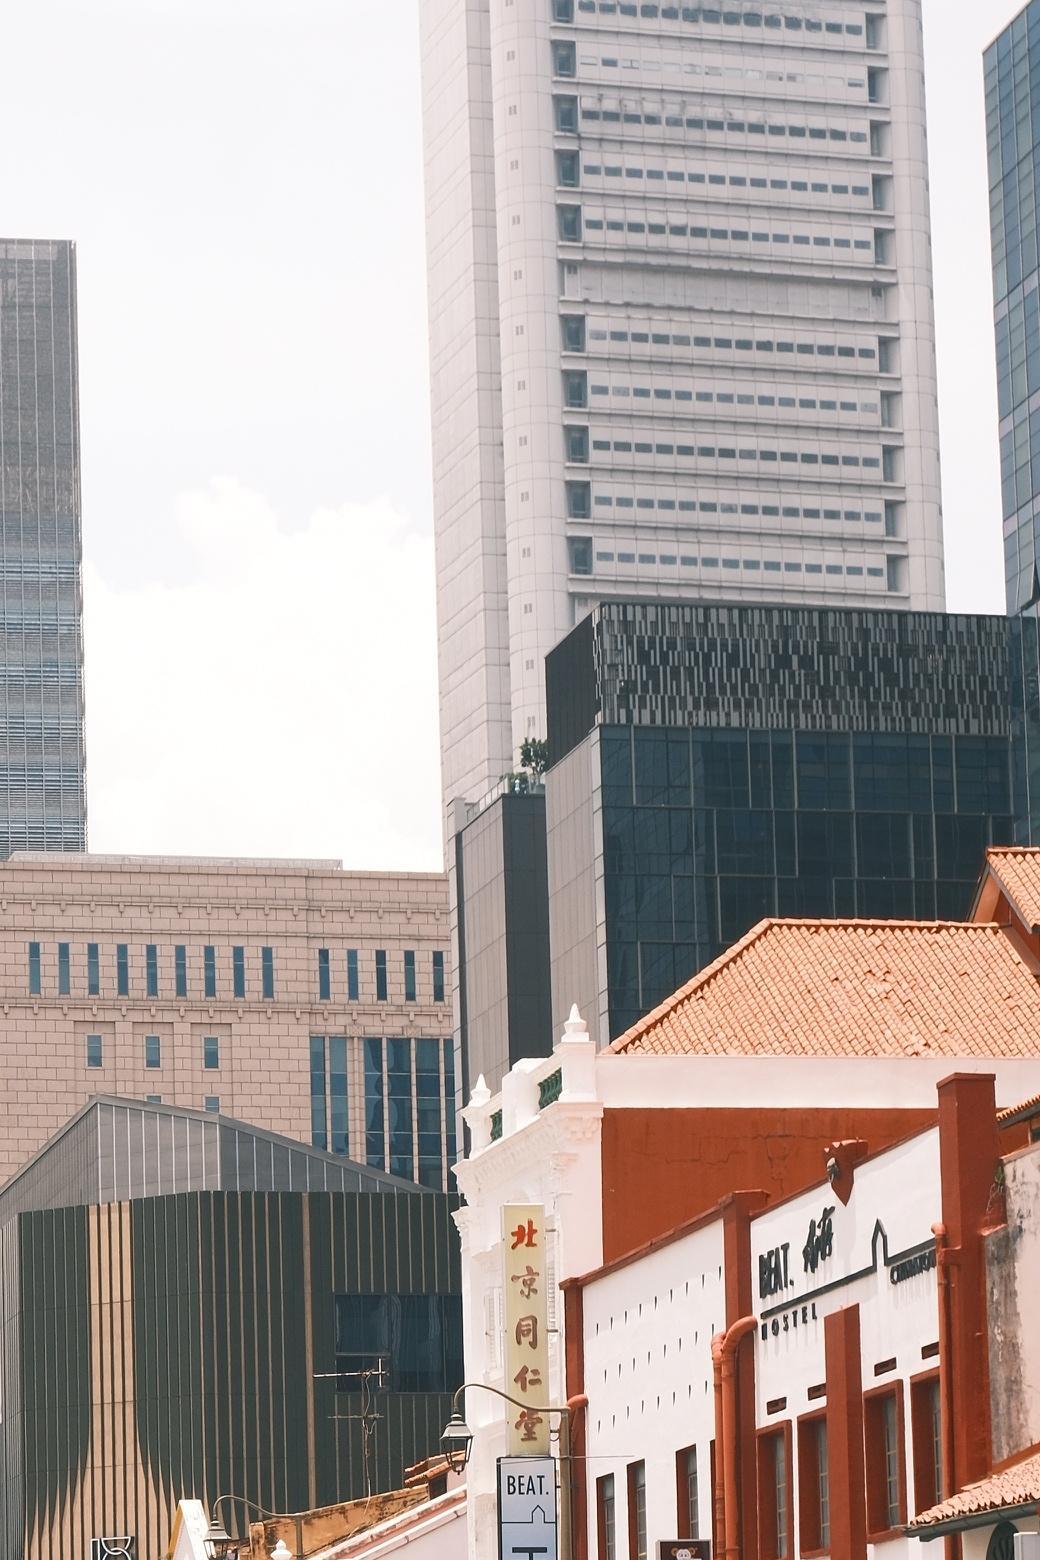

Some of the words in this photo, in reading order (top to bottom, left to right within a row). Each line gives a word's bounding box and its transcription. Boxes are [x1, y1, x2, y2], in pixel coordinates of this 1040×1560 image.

[510, 1217, 543, 1442] 北京同仁堂
[761, 1302, 818, 1341] HOSTEL
[507, 1475, 549, 1496] BEAT.
